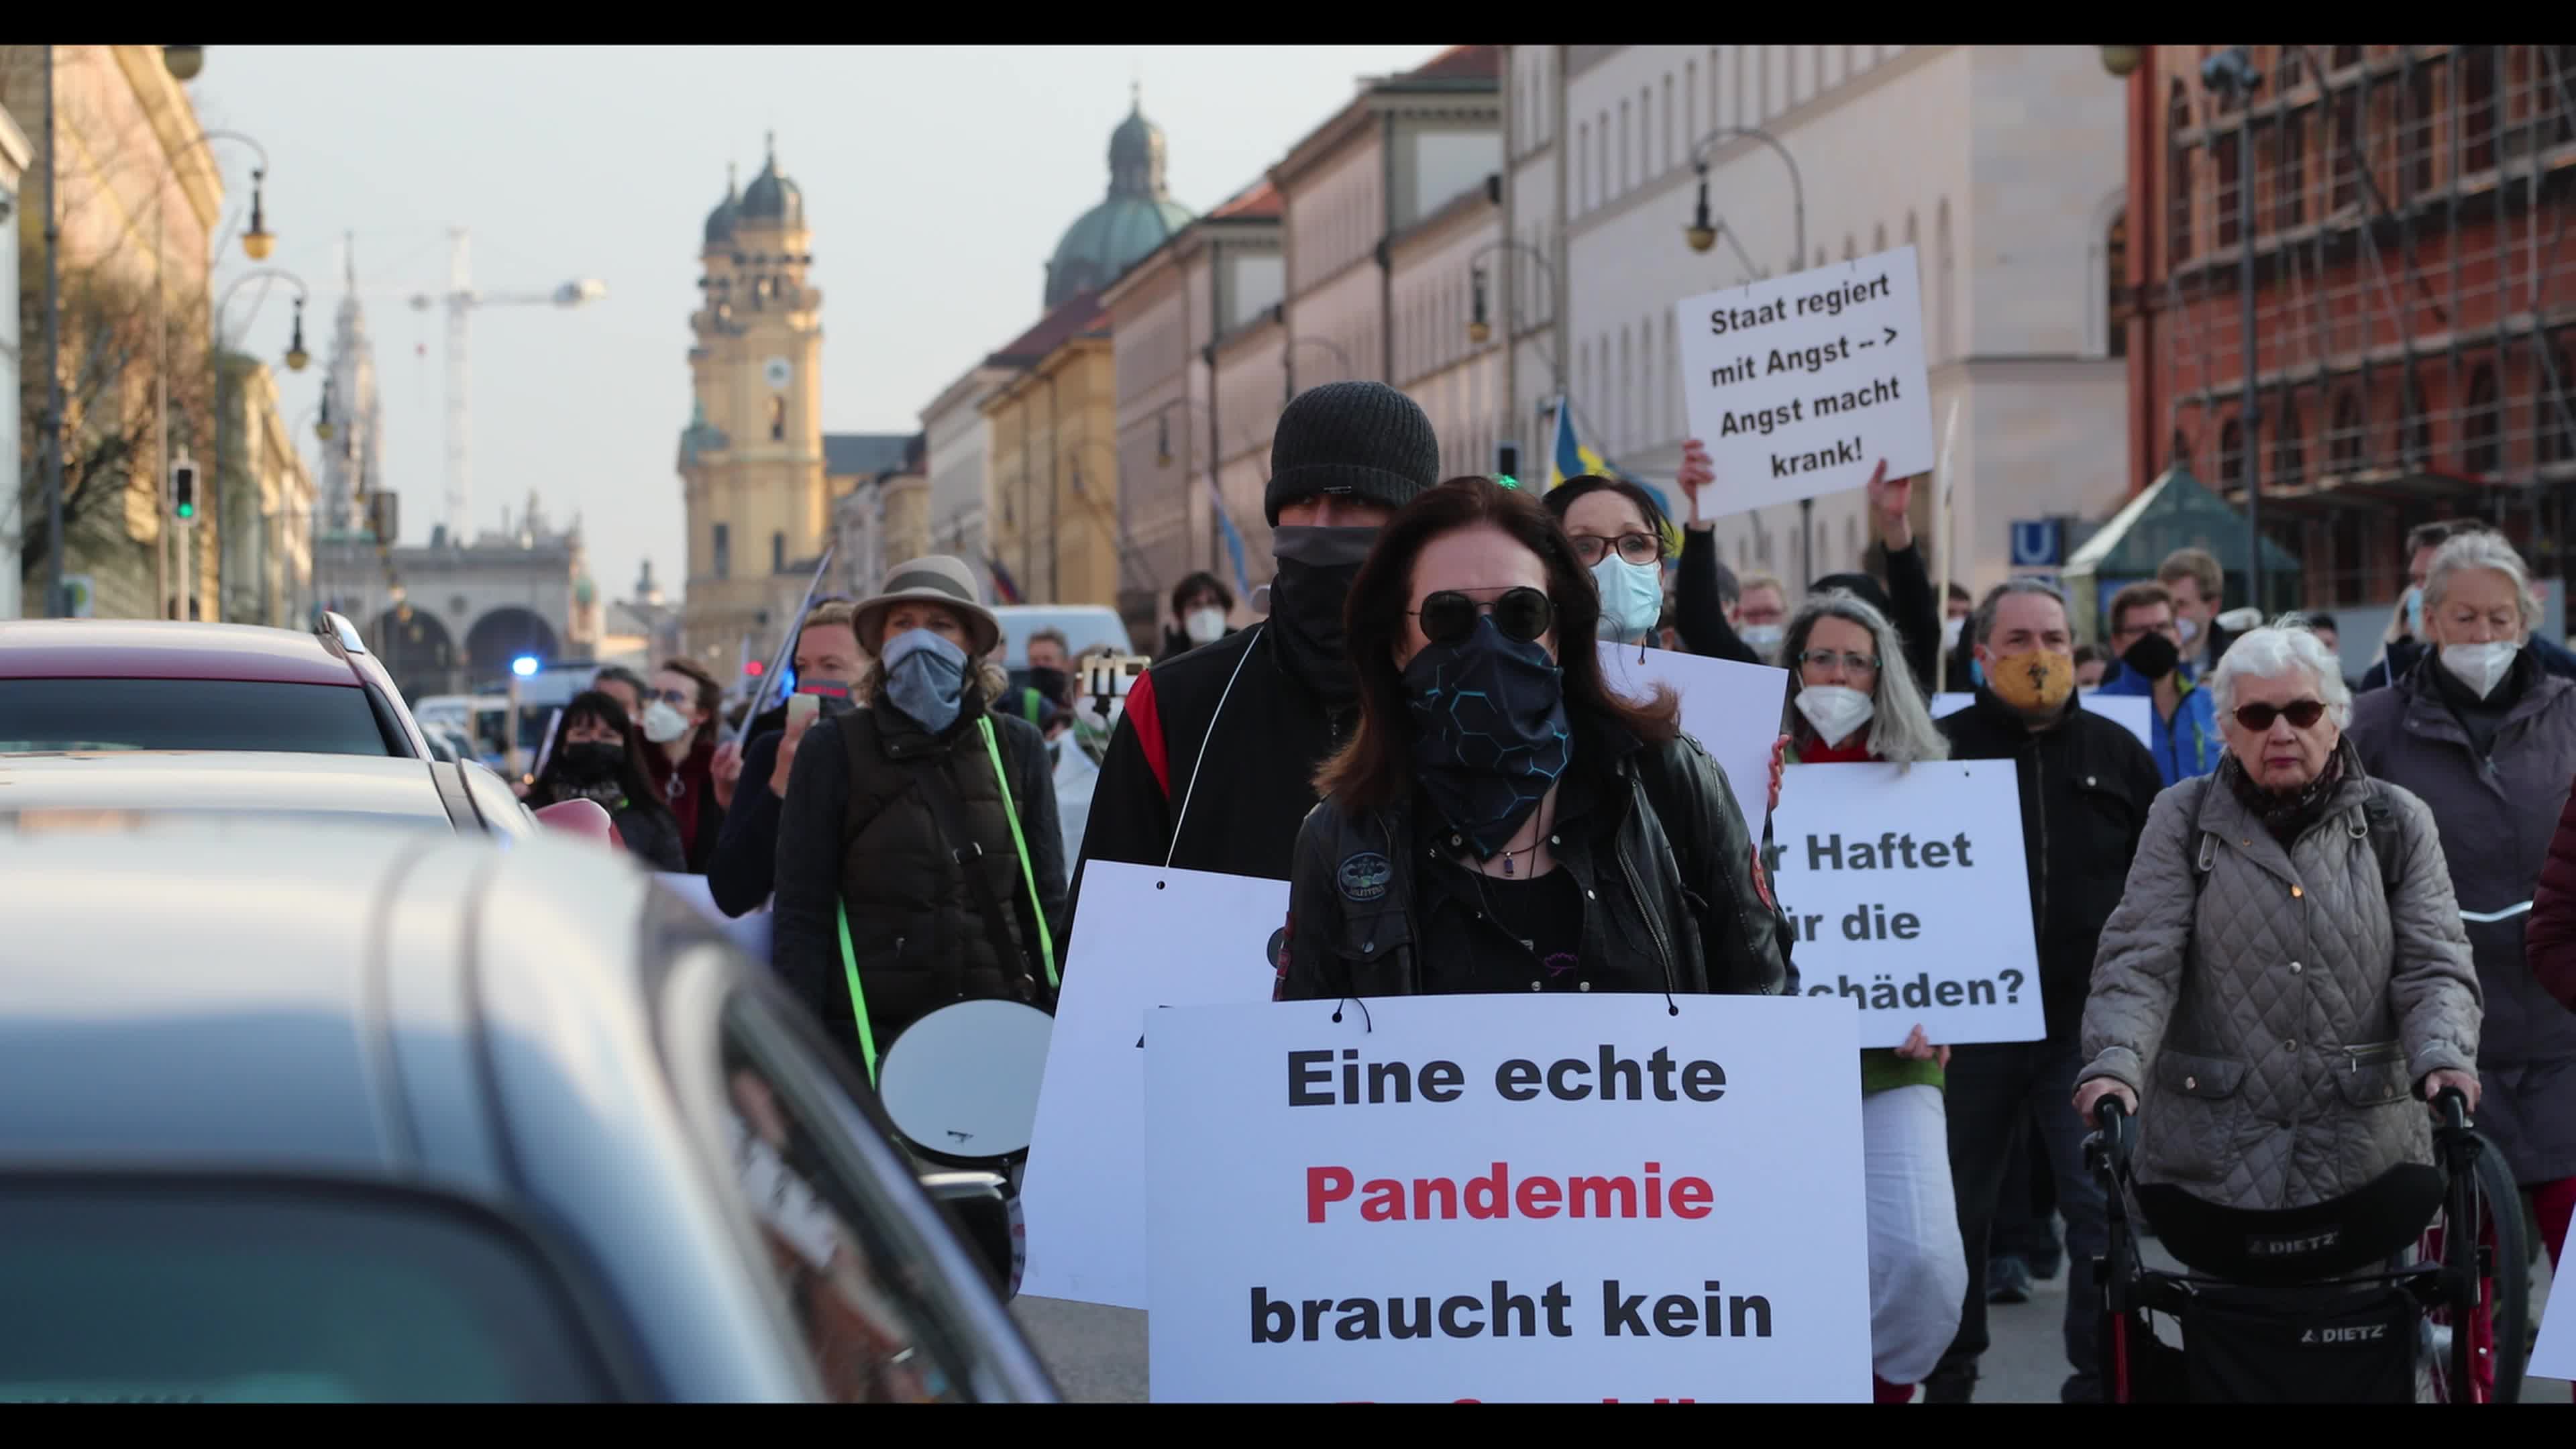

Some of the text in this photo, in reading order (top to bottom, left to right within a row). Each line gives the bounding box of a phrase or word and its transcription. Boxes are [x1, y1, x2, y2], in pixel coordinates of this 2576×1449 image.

[1710, 272, 1890, 335] Staat regiert
[1711, 356, 1756, 388] mit
[1766, 335, 1850, 375] Angst
[1720, 376, 1900, 437] Angst macht
[1770, 436, 1863, 478] krank!
[2016, 522, 2053, 566] U
[1806, 832, 1974, 871] Haftet
[1841, 904, 1921, 941] die
[1287, 1044, 1727, 1108] Eine echte
[1306, 1161, 1715, 1224] Pandemie
[2269, 1234, 2334, 1254] DIETZ
[1250, 1279, 1772, 1344] braucht kein
[2322, 1325, 2383, 1342] DIETZ
